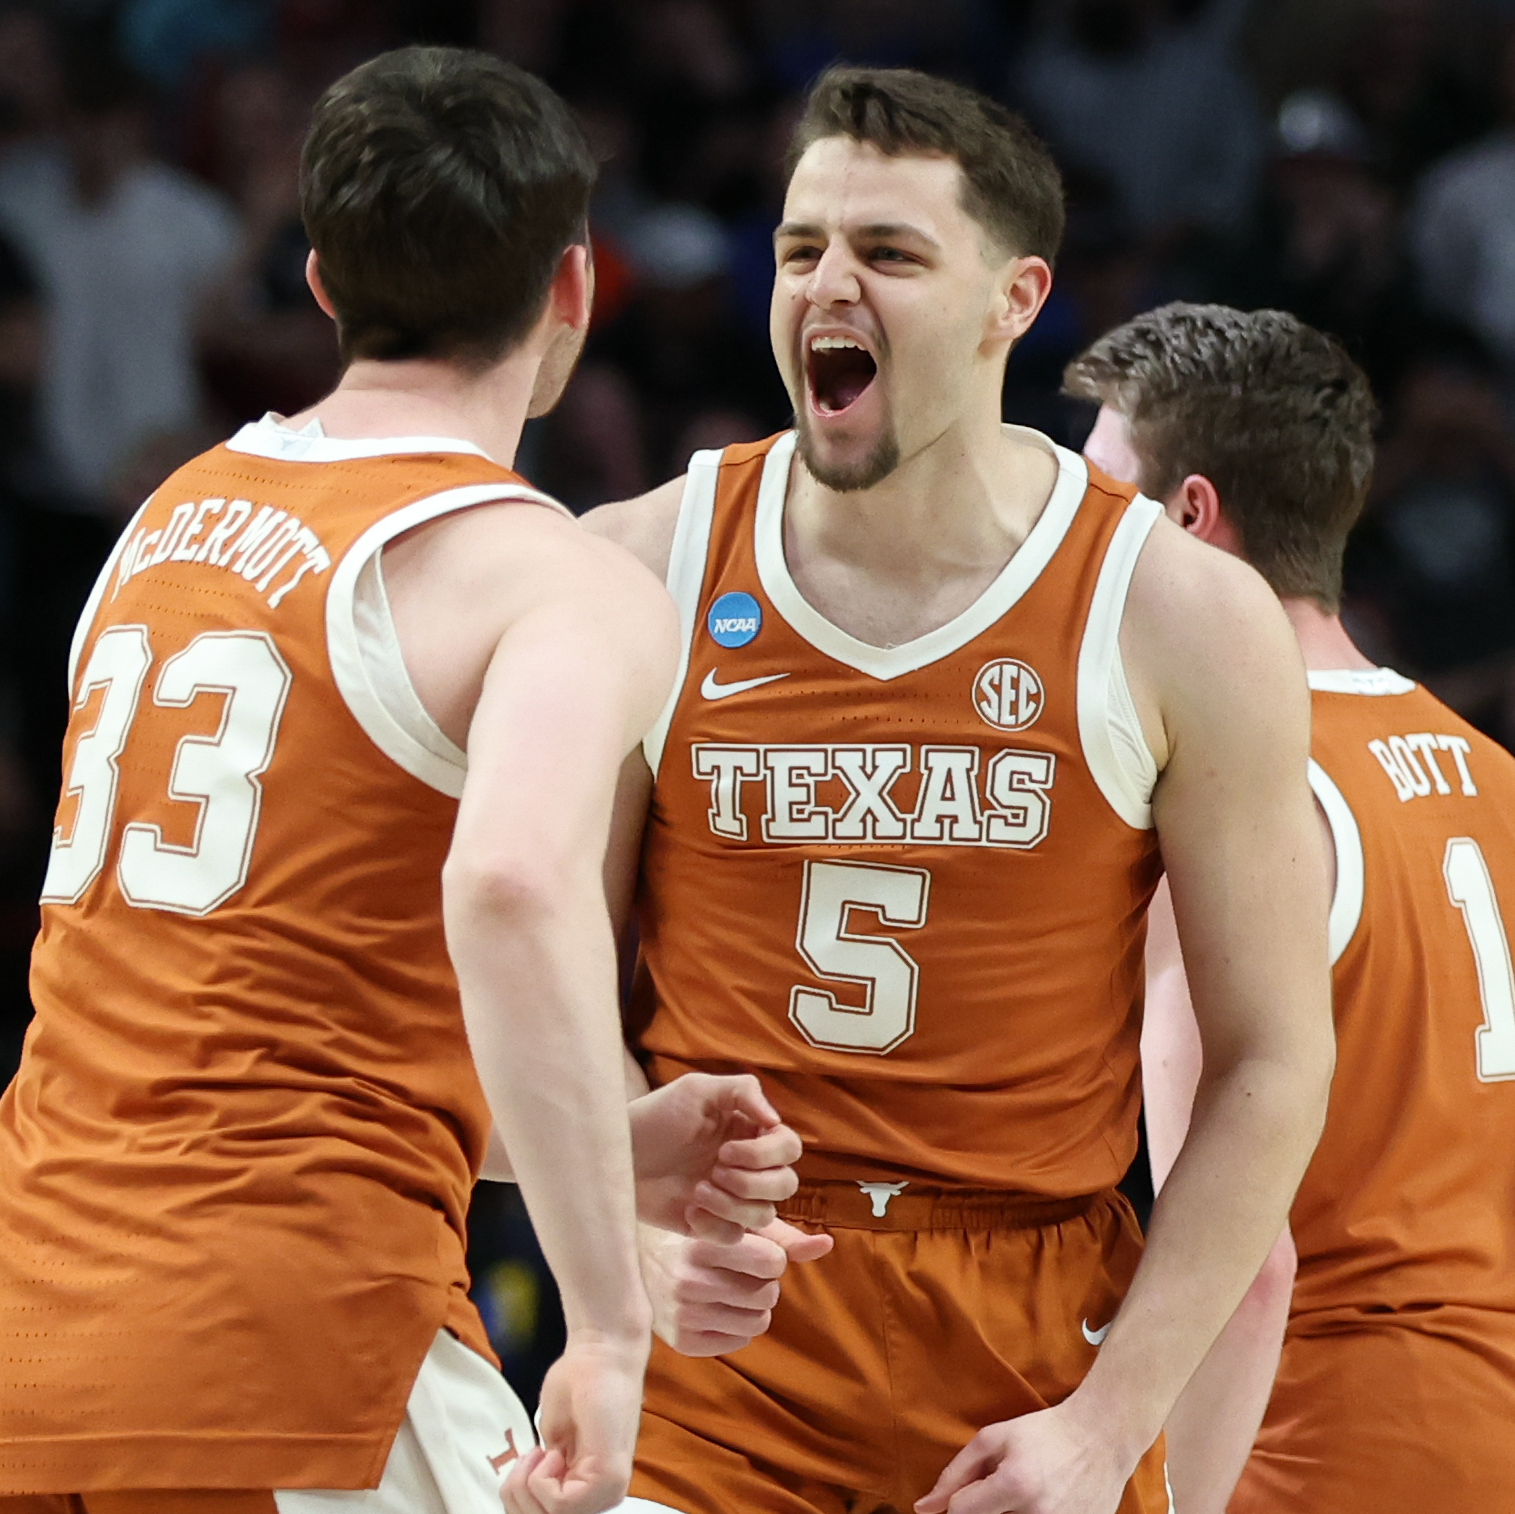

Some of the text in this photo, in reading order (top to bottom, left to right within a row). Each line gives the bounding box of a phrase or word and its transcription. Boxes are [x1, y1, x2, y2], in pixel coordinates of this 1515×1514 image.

[714, 617, 756, 634] NCAA
[979, 663, 1038, 726] SEC
[40, 624, 292, 917] 33
[691, 743, 1055, 849] TEXAS
[1368, 733, 1477, 802] BOTT
[788, 859, 931, 1056] 5
